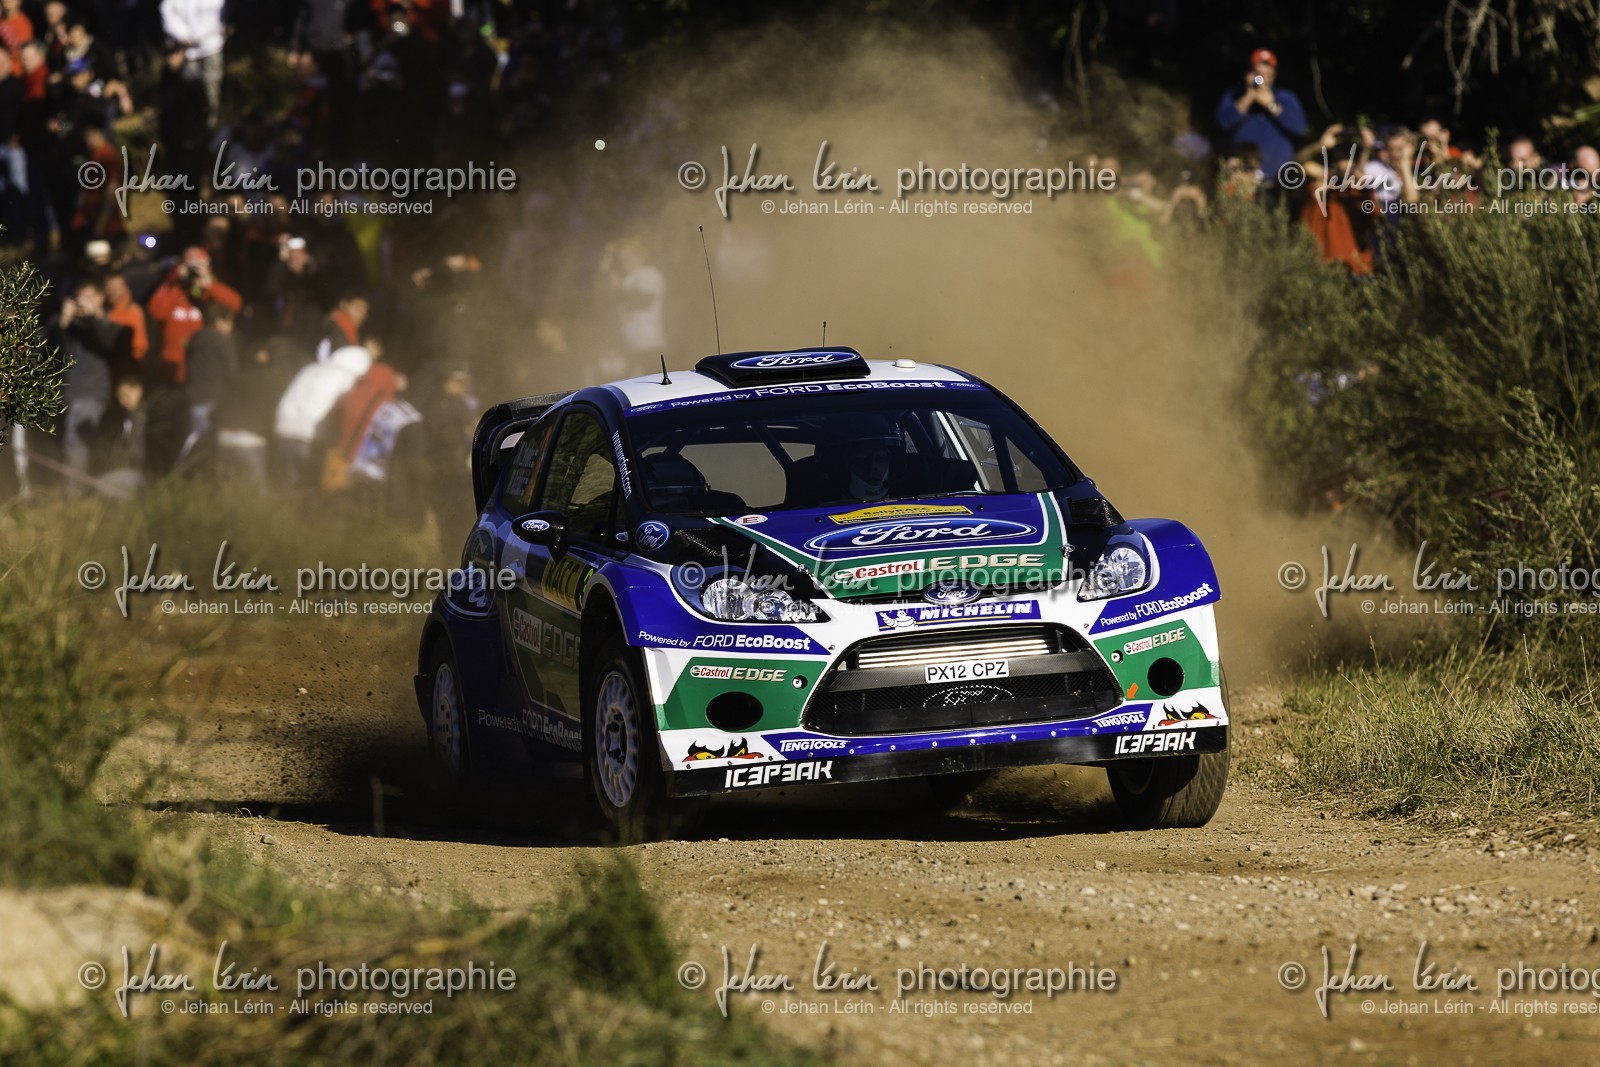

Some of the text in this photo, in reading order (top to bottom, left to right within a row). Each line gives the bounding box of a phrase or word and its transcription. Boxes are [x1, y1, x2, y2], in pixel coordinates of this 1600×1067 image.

[757, 353, 834, 367] Ford
[671, 381, 945, 407] Powered by FORD EcoBoost
[526, 520, 544, 530] Ford
[851, 522, 991, 546] Ford
[639, 524, 663, 548] Ford
[855, 553, 1046, 579] Castrol EDGE
[937, 586, 968, 600] Ford
[919, 602, 1032, 620] MICHELIN
[1100, 582, 1213, 627] Powered by FORD EcoBoost
[639, 631, 811, 650] Powered by FORD EcoBoost
[1131, 627, 1186, 652] Castrol EDGE
[700, 667, 787, 682] Castrol EDGE
[927, 661, 1007, 680] PX12 CPZ
